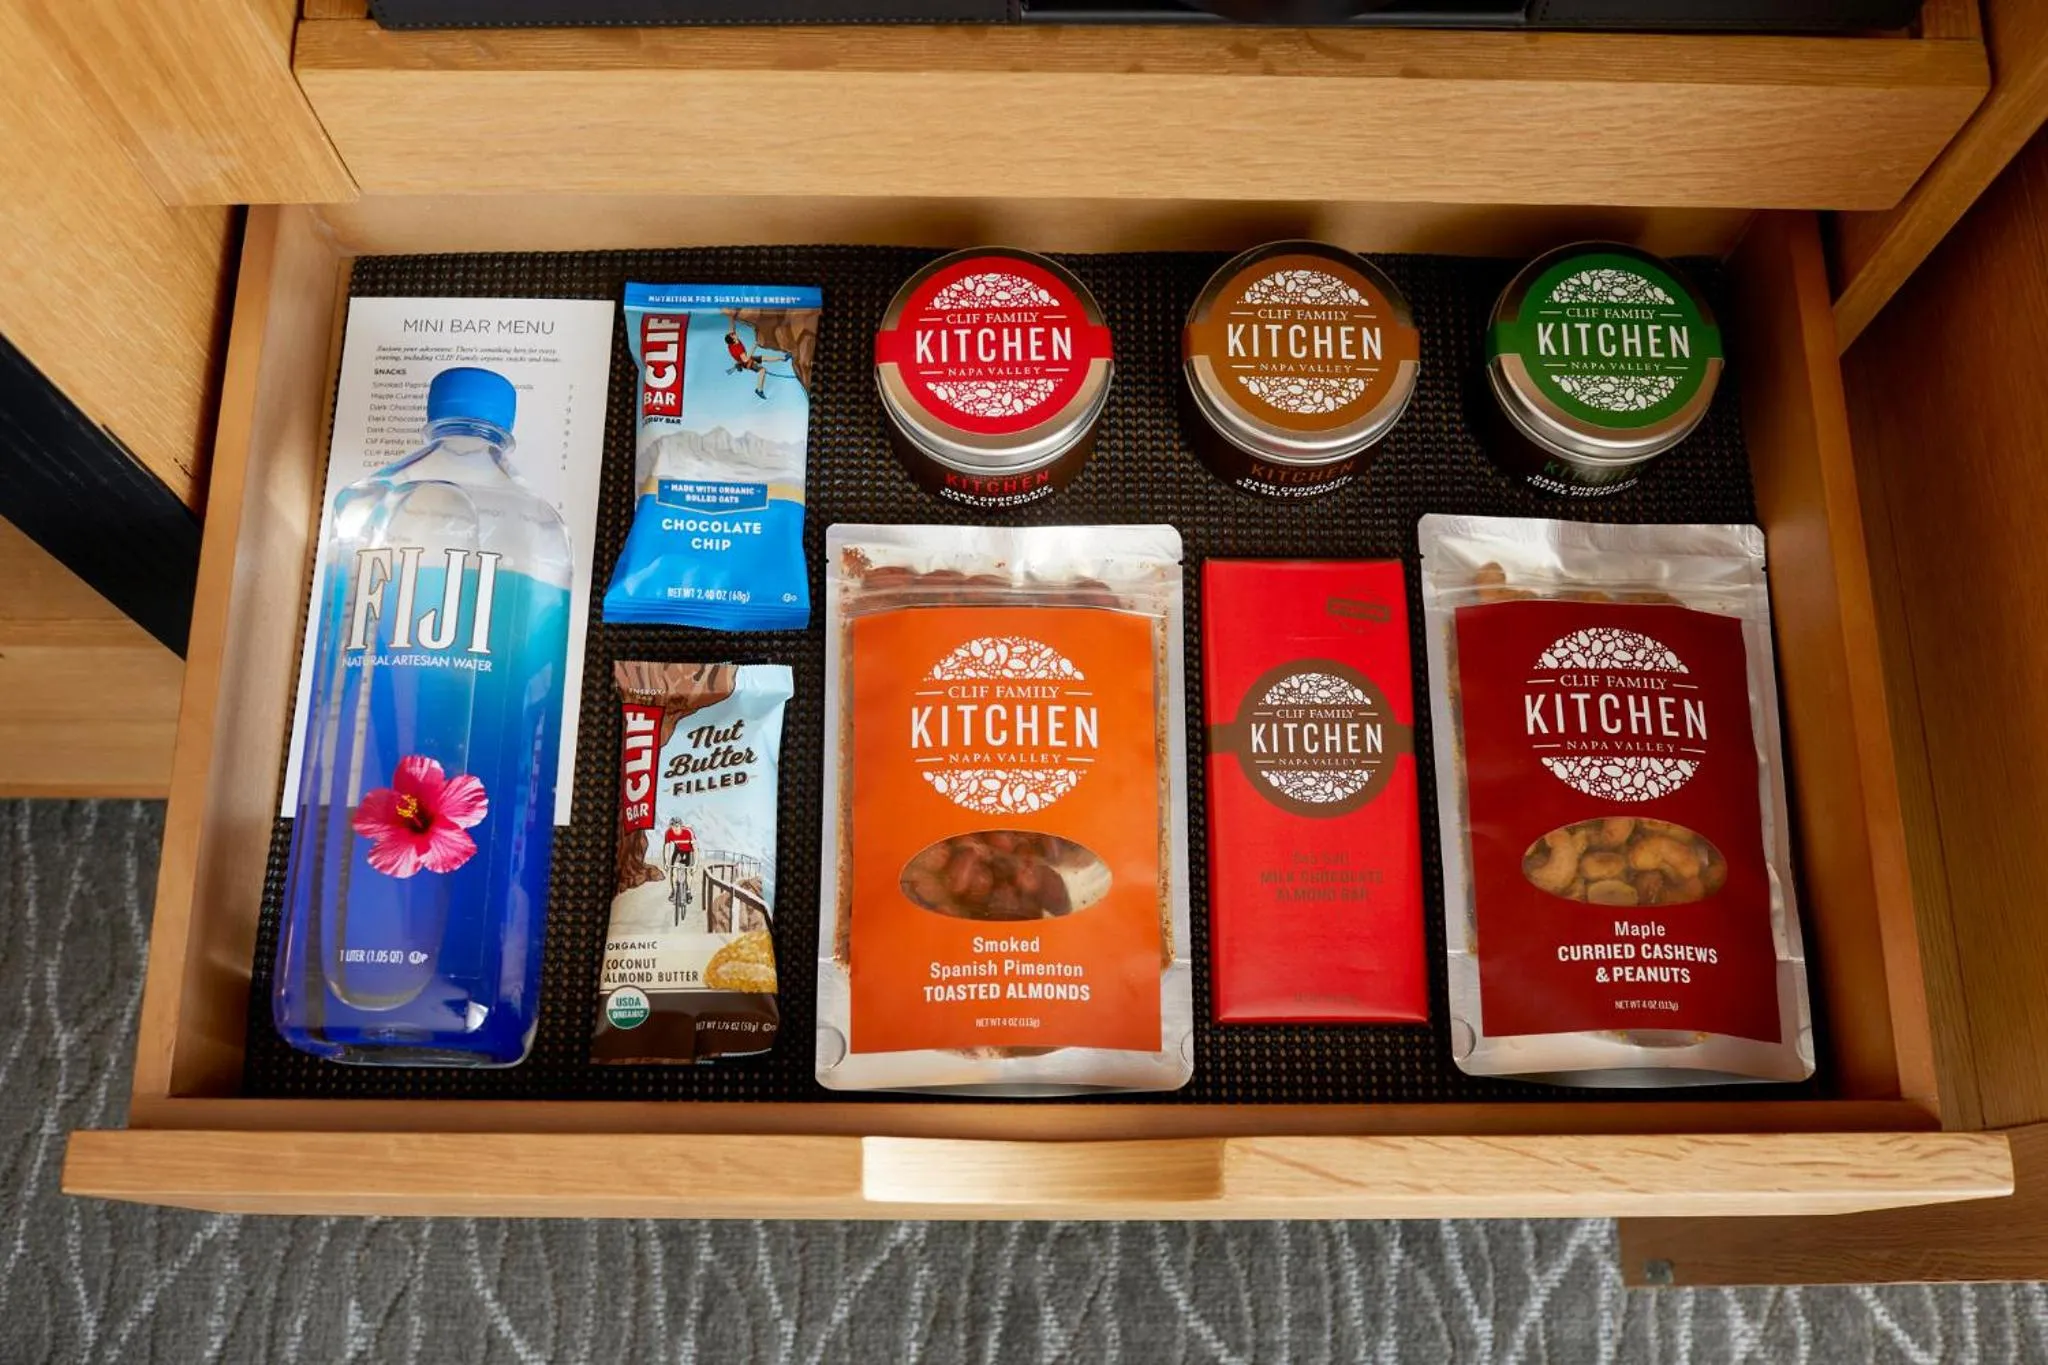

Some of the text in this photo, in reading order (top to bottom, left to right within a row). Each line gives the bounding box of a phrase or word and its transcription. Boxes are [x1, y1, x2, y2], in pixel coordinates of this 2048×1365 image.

[946, 312, 1039, 324] CLIF FAMILY
[1257, 309, 1349, 321] CLIF FAMILY
[1566, 308, 1656, 320] CLIF FAMILY
[403, 319, 554, 335] MINI BAR MENU
[915, 327, 1072, 364] KITCHEN
[1227, 324, 1382, 360] KITCHEN
[1537, 323, 1690, 358] KITCHEN
[645, 318, 680, 389] CLIF
[374, 368, 406, 376] SNACKS
[948, 366, 1041, 377] NAPA VALLEY
[1259, 363, 1352, 374] NAPA VALLEY
[1571, 362, 1661, 371] NAPA VALLEY
[644, 391, 676, 406] BAR
[665, 417, 682, 425] BAR
[379, 438, 405, 446] Family
[1252, 460, 1354, 482] KITCHEN
[944, 469, 1049, 493] KITCHEN
[671, 484, 755, 495] MADE WITH ORGANIC
[944, 485, 1050, 502] DARK CHOCOLATE
[685, 494, 740, 503] ROLLED OATS
[965, 499, 992, 507] SALT
[661, 518, 762, 534] CHOCOLATE
[691, 538, 732, 551] CHIP
[345, 547, 503, 654] FIJI
[667, 587, 682, 598] NET
[682, 588, 695, 599] WT
[716, 591, 727, 600] OZ
[728, 590, 751, 604] (68g)
[342, 654, 492, 673] NATURAL ARTESIAN WATER
[1560, 675, 1668, 690] CLIF FAMILY
[948, 686, 1060, 699] CLIF FAMILY
[1276, 709, 1355, 719] CLIF FAMILY
[1524, 693, 1708, 740] KITCHEN
[911, 703, 1099, 749] KITCHEN
[687, 719, 745, 749] Nut
[1251, 723, 1383, 754] KITCHEN
[1566, 741, 1676, 753] NAPA VALLEY
[626, 712, 655, 802] CLIF
[663, 745, 759, 779] Butter
[949, 753, 1062, 763] NAPA VALLEY
[1279, 758, 1358, 766] NAPA VALLEY
[672, 772, 748, 796] FILLED
[626, 803, 649, 821] BAR
[1261, 870, 1384, 884] MILK CHOCOLATE
[1276, 887, 1368, 901] ALMOND BAR
[1614, 920, 1666, 940] Maple
[607, 941, 658, 951] ORGANIC
[972, 936, 1040, 953] Smoked
[339, 949, 345, 962] 1
[345, 949, 366, 962] LITER
[366, 949, 388, 964] (1.05
[389, 950, 404, 964] QT)
[1557, 943, 1718, 964] CURRIED CASHEWS
[606, 958, 657, 970] COCONUT
[930, 959, 1083, 981] Spanish Pimenton
[604, 971, 699, 983] ALMOND BUTTER
[1595, 966, 1691, 984] & PEANUTS
[923, 982, 1091, 1002] TOASTED ALMONDS
[616, 996, 641, 1007] USDA
[1614, 999, 1629, 1009] NET
[1629, 999, 1641, 1009] WT
[1641, 1000, 1647, 1009] 4
[1658, 1000, 1679, 1012] (113g)
[612, 1009, 645, 1019] ORGANIC
[706, 1021, 717, 1030] WT
[730, 1022, 740, 1031] OZ
[975, 1017, 1040, 1028] NET WT 4 OZ (113g)
